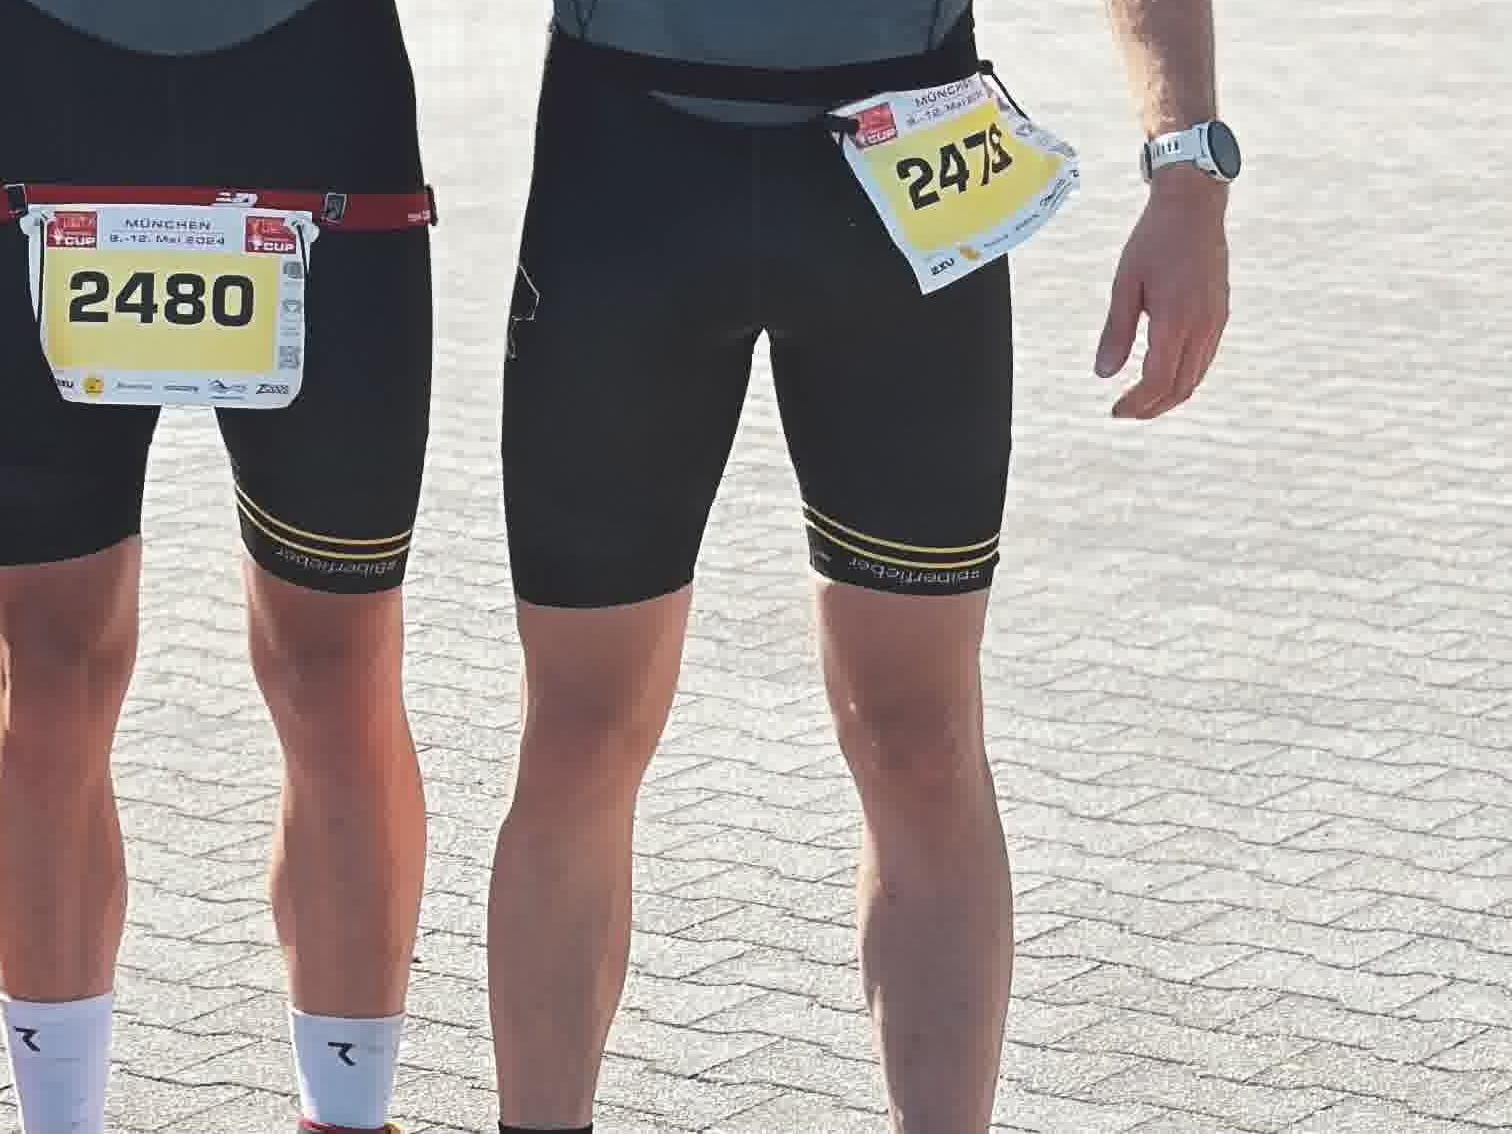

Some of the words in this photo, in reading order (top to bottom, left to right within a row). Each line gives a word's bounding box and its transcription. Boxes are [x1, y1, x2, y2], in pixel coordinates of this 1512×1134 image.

[125, 218, 211, 231] MÜNCHEN
[186, 235, 226, 246] 2024
[263, 241, 295, 252] CUP
[69, 271, 254, 327] 2480
